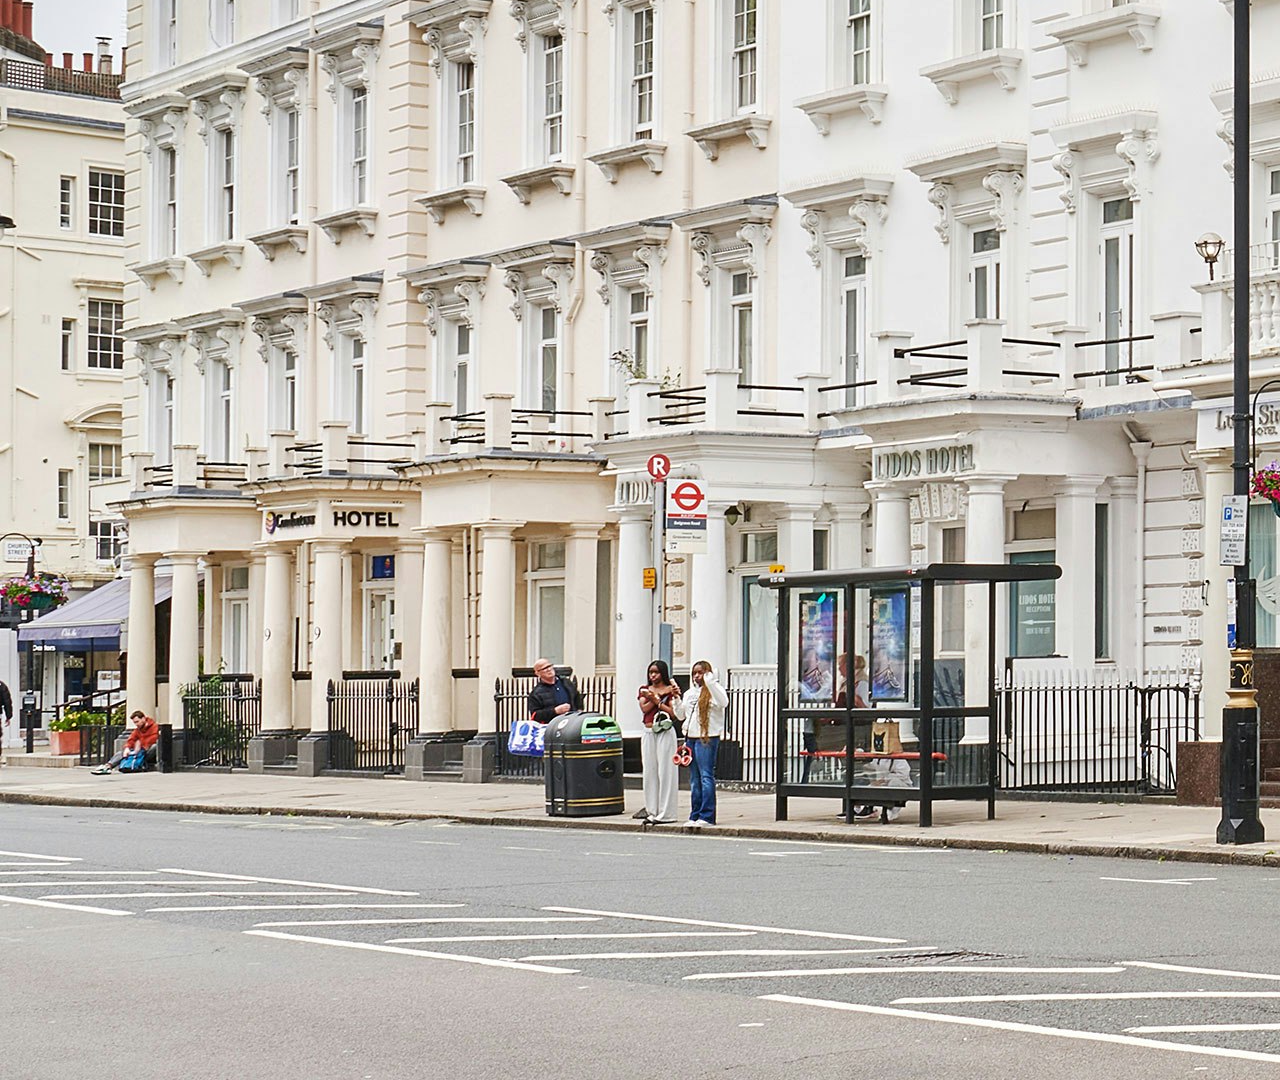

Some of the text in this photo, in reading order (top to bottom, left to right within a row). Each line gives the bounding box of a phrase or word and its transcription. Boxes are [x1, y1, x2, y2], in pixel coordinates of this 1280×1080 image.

[653, 457, 666, 476] R
[874, 444, 975, 479] LIDOS HOTEL
[334, 511, 399, 526] HOTEL
[1019, 594, 1055, 605] LIDOS HOTE
[265, 628, 271, 641] 9
[314, 626, 321, 640] 9
